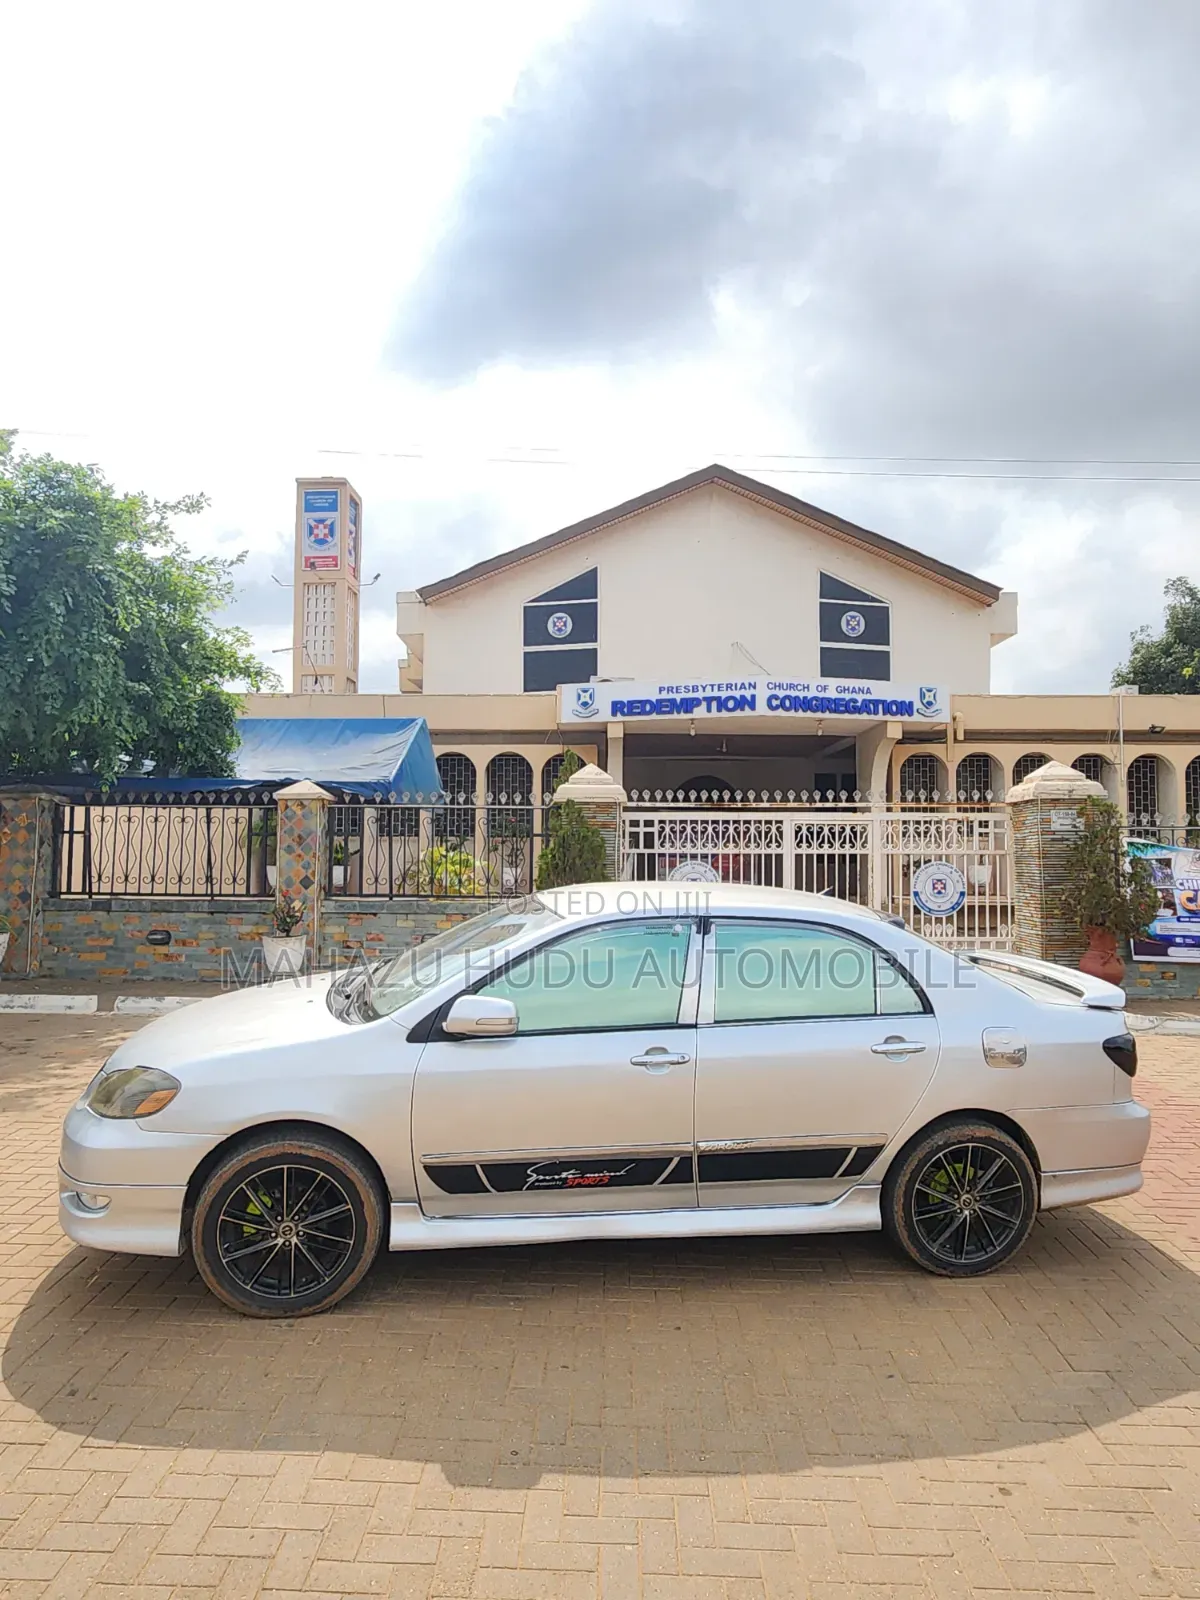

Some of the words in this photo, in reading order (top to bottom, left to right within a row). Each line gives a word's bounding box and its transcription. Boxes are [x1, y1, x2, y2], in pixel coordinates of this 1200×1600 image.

[658, 682, 757, 694] PRESBYTERIAN
[766, 682, 810, 692] CHURCH
[816, 685, 829, 693] OF
[835, 685, 872, 695] GHANA
[610, 694, 756, 717] REDEMPTION
[766, 694, 914, 717] CONGREGATION
[563, 1175, 610, 1187] SPORTS
